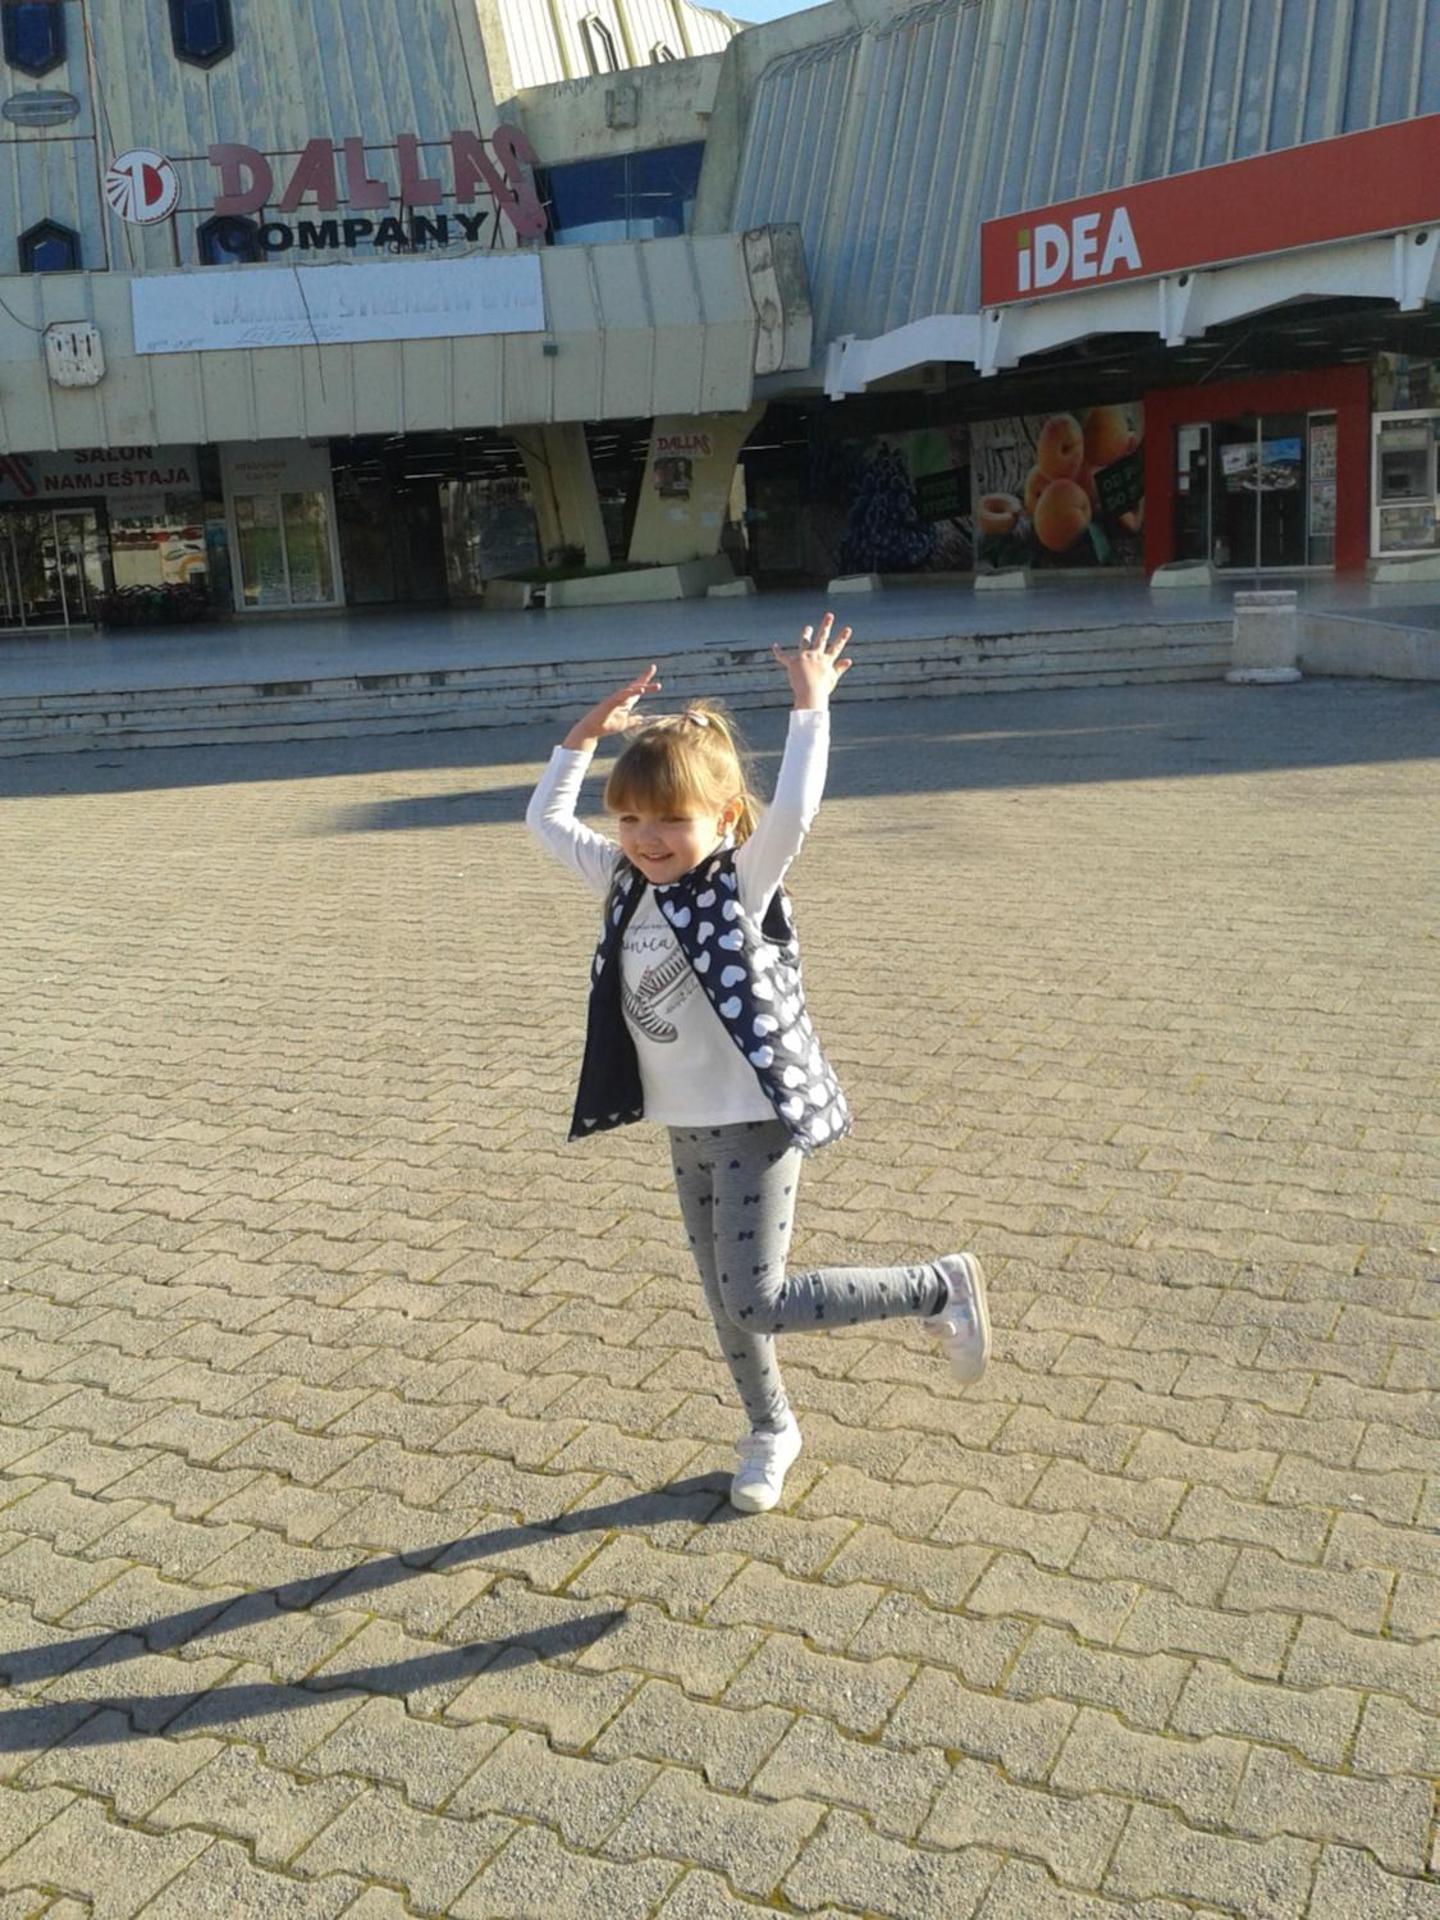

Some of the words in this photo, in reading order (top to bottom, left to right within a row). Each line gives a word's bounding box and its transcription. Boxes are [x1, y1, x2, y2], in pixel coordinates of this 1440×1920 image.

[208, 125, 547, 239] DALLAS
[219, 211, 489, 254] COMPANY
[74, 446, 153, 464] SALON
[656, 434, 711, 456] DALLAS
[44, 467, 191, 491] NAMJEŠTAJA
